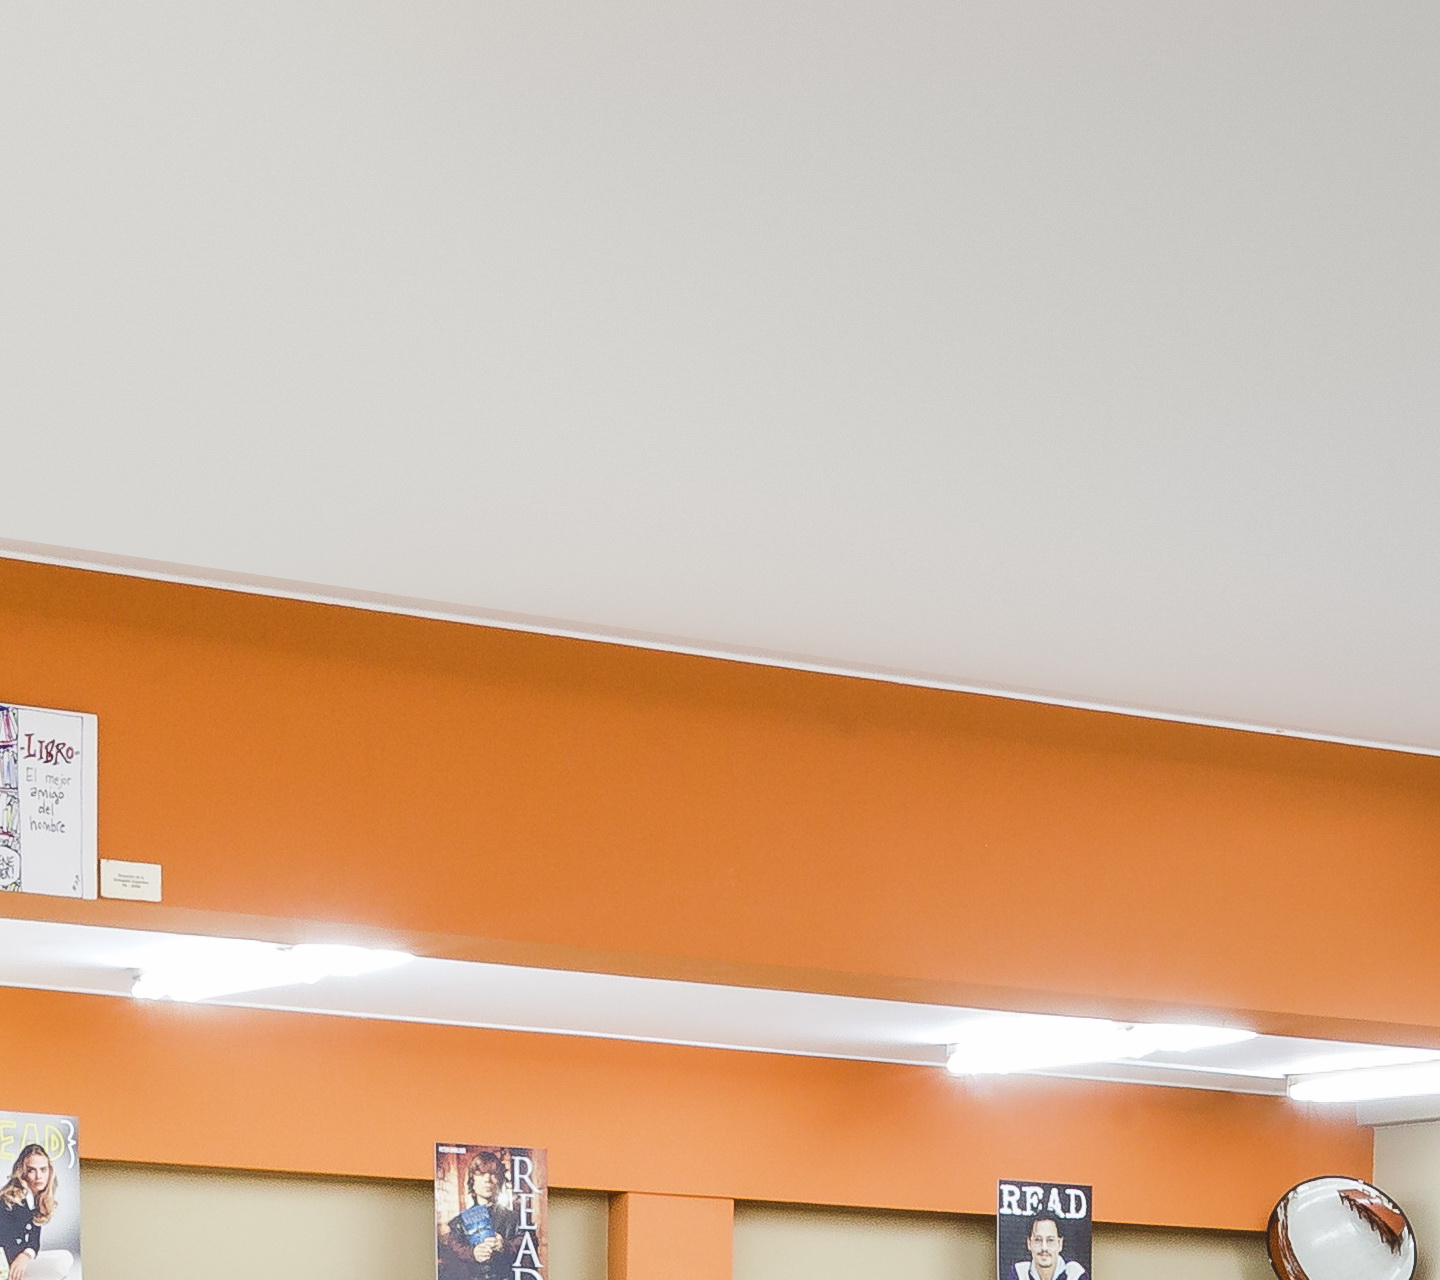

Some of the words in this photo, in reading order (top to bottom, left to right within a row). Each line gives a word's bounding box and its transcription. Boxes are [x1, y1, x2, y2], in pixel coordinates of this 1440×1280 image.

[26, 767, 37, 783] El
[45, 774, 72, 788] mejor
[30, 787, 65, 805] amigo
[38, 800, 54, 816] del
[29, 816, 66, 833] hombre
[999, 1183, 1087, 1219] READ
